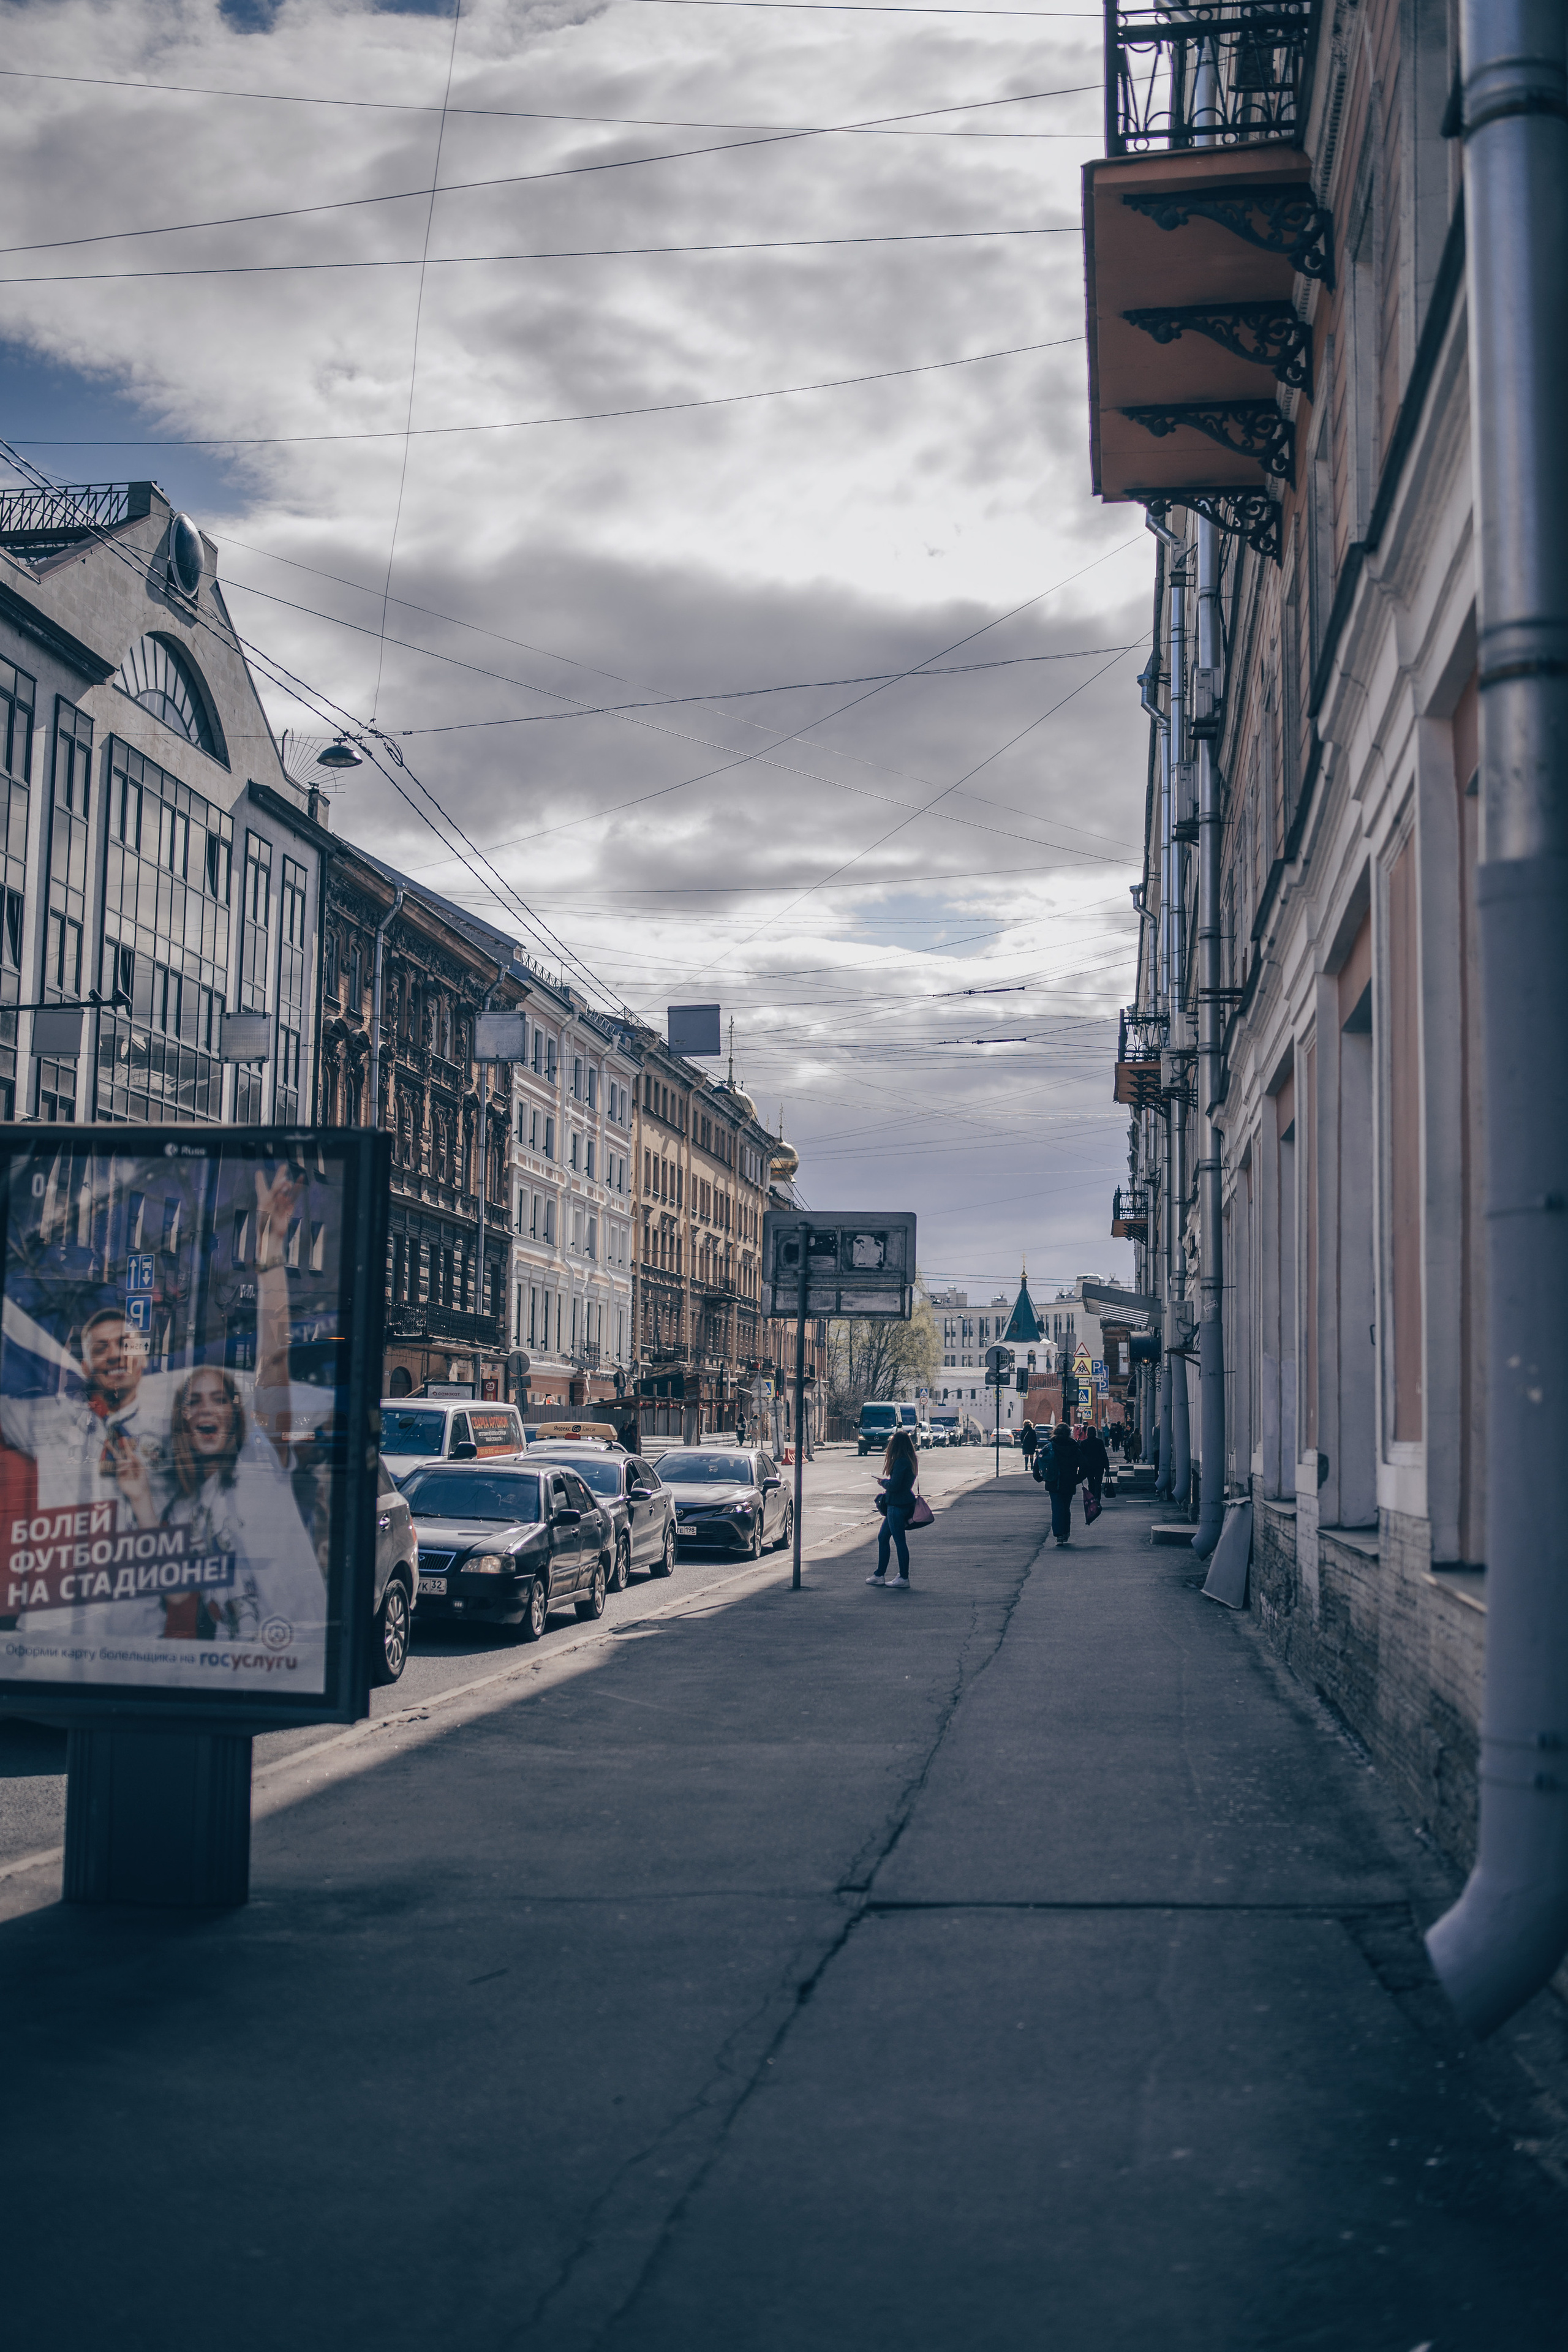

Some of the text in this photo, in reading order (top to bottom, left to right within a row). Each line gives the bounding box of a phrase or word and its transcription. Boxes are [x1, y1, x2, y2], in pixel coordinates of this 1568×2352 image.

[1093, 1362, 1101, 1373] P
[1099, 1381, 1106, 1391] P
[11, 1502, 111, 1544] БОЛЕЙ
[9, 1530, 184, 1574] ФУТБОЛОМ
[7, 1555, 228, 1607] НА СТАДИОНЕ!
[431, 1580, 442, 1589] 32
[6, 1643, 58, 1659] Оформи
[62, 1647, 96, 1662] карту
[99, 1646, 176, 1664] болельщика
[179, 1654, 195, 1664] на
